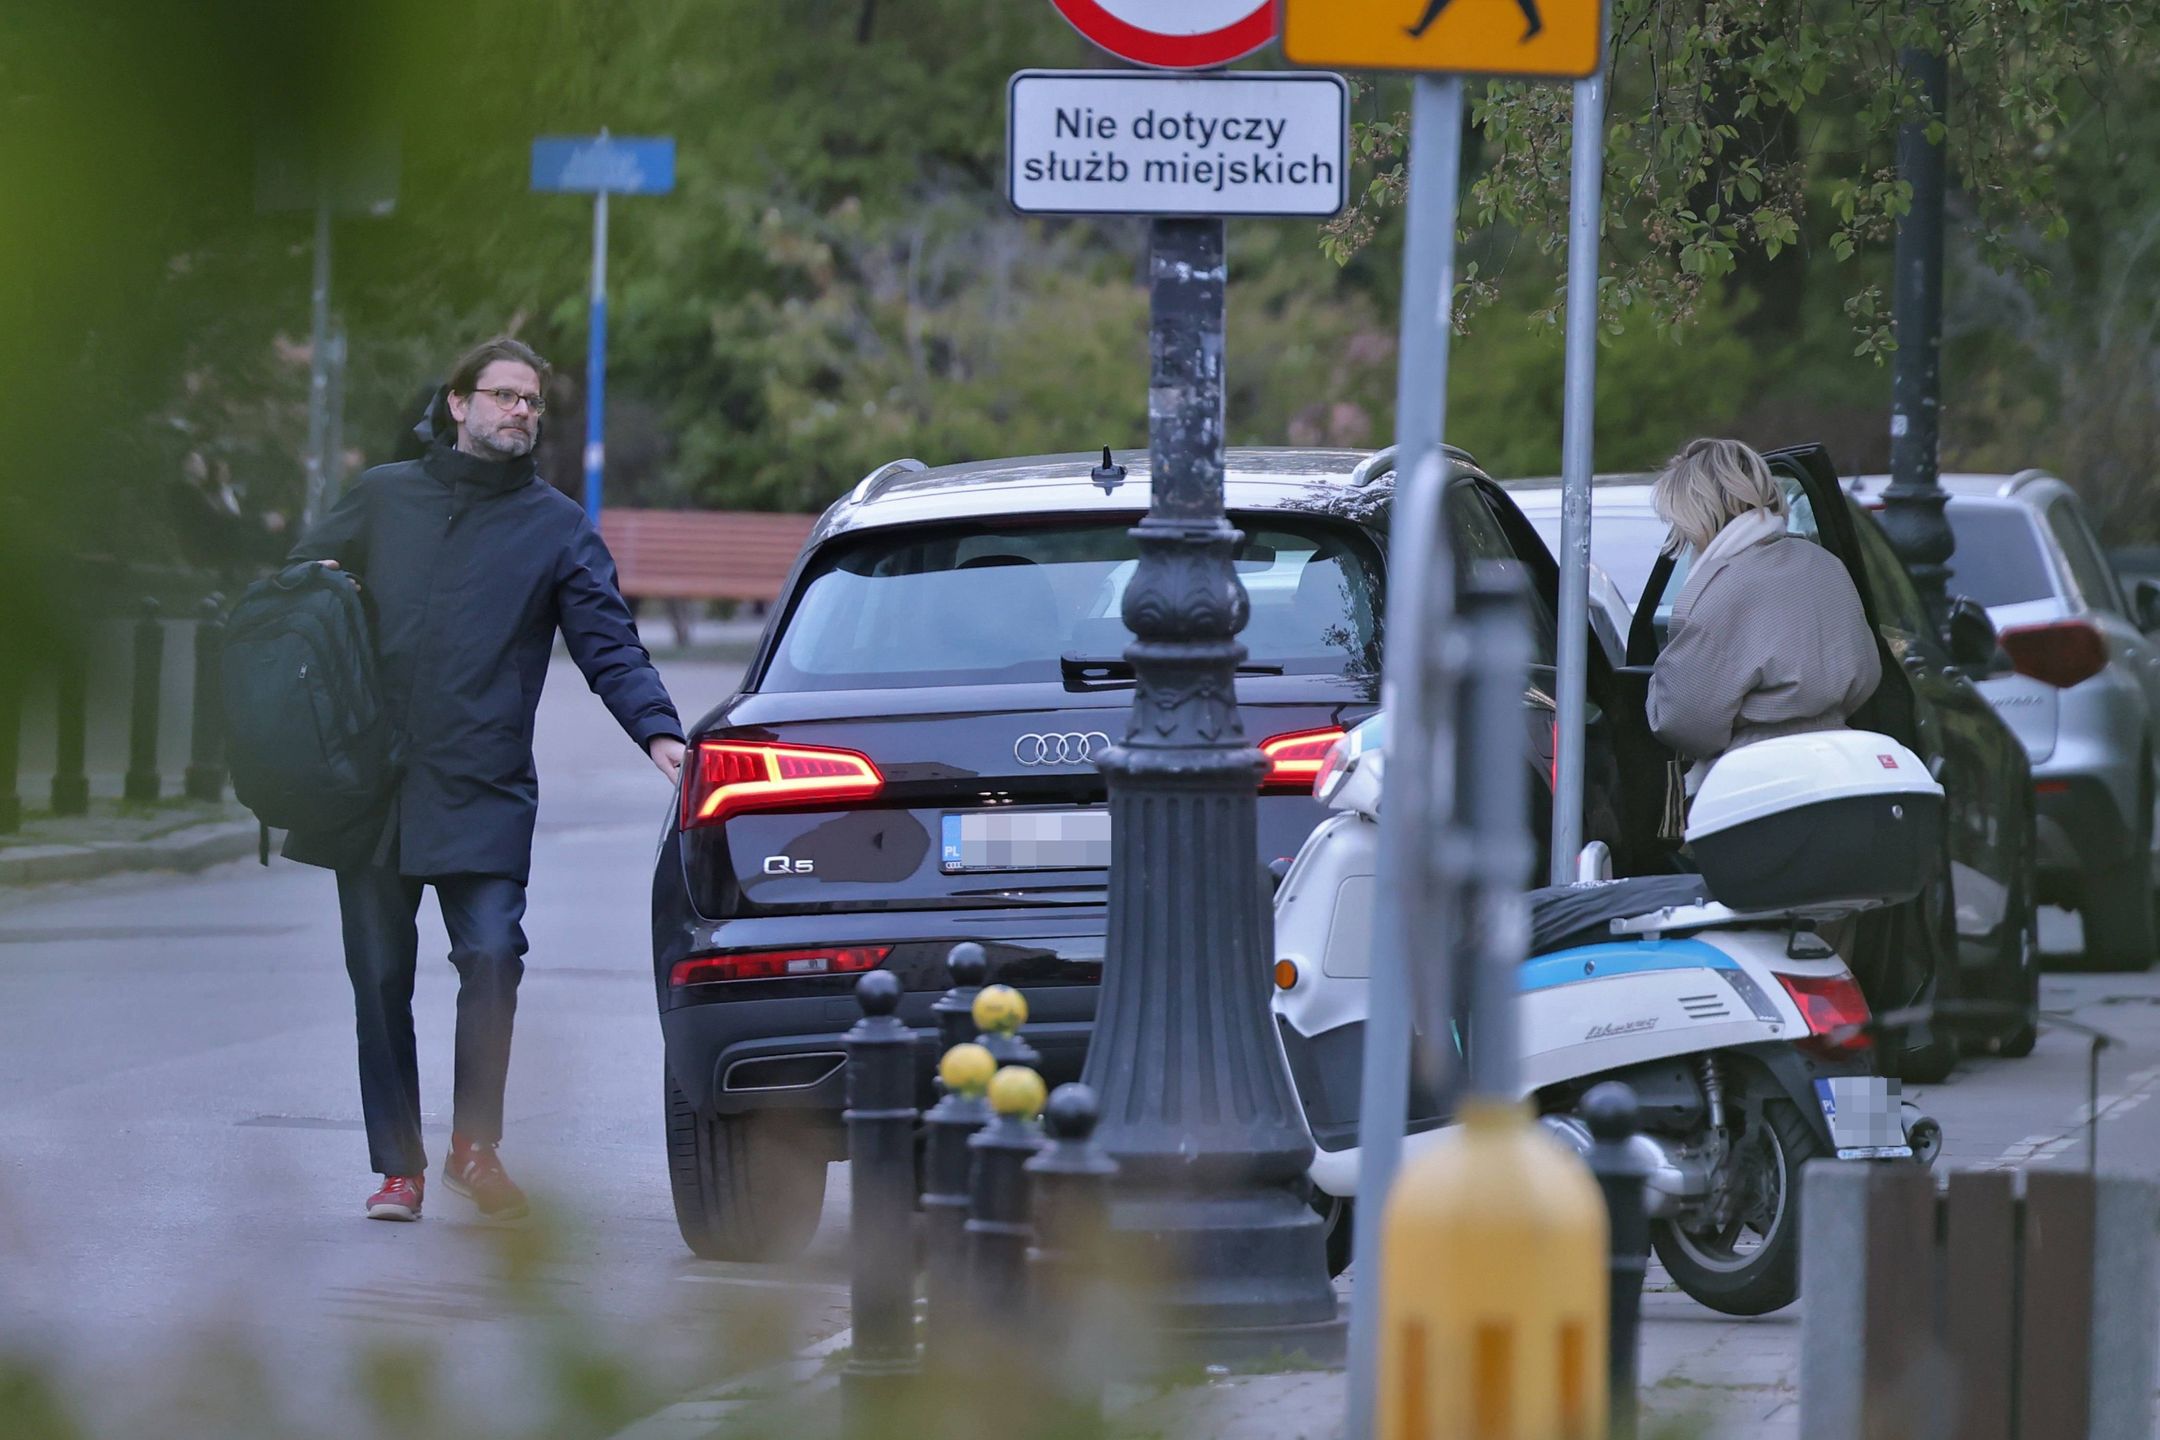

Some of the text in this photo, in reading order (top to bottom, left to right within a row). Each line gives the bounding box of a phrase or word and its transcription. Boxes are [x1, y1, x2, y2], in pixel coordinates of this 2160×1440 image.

[1055, 107, 1286, 149] Nie dotyczy
[1024, 150, 1333, 192] służb miejskich
[764, 855, 814, 875] Q5
[944, 846, 961, 857] PL
